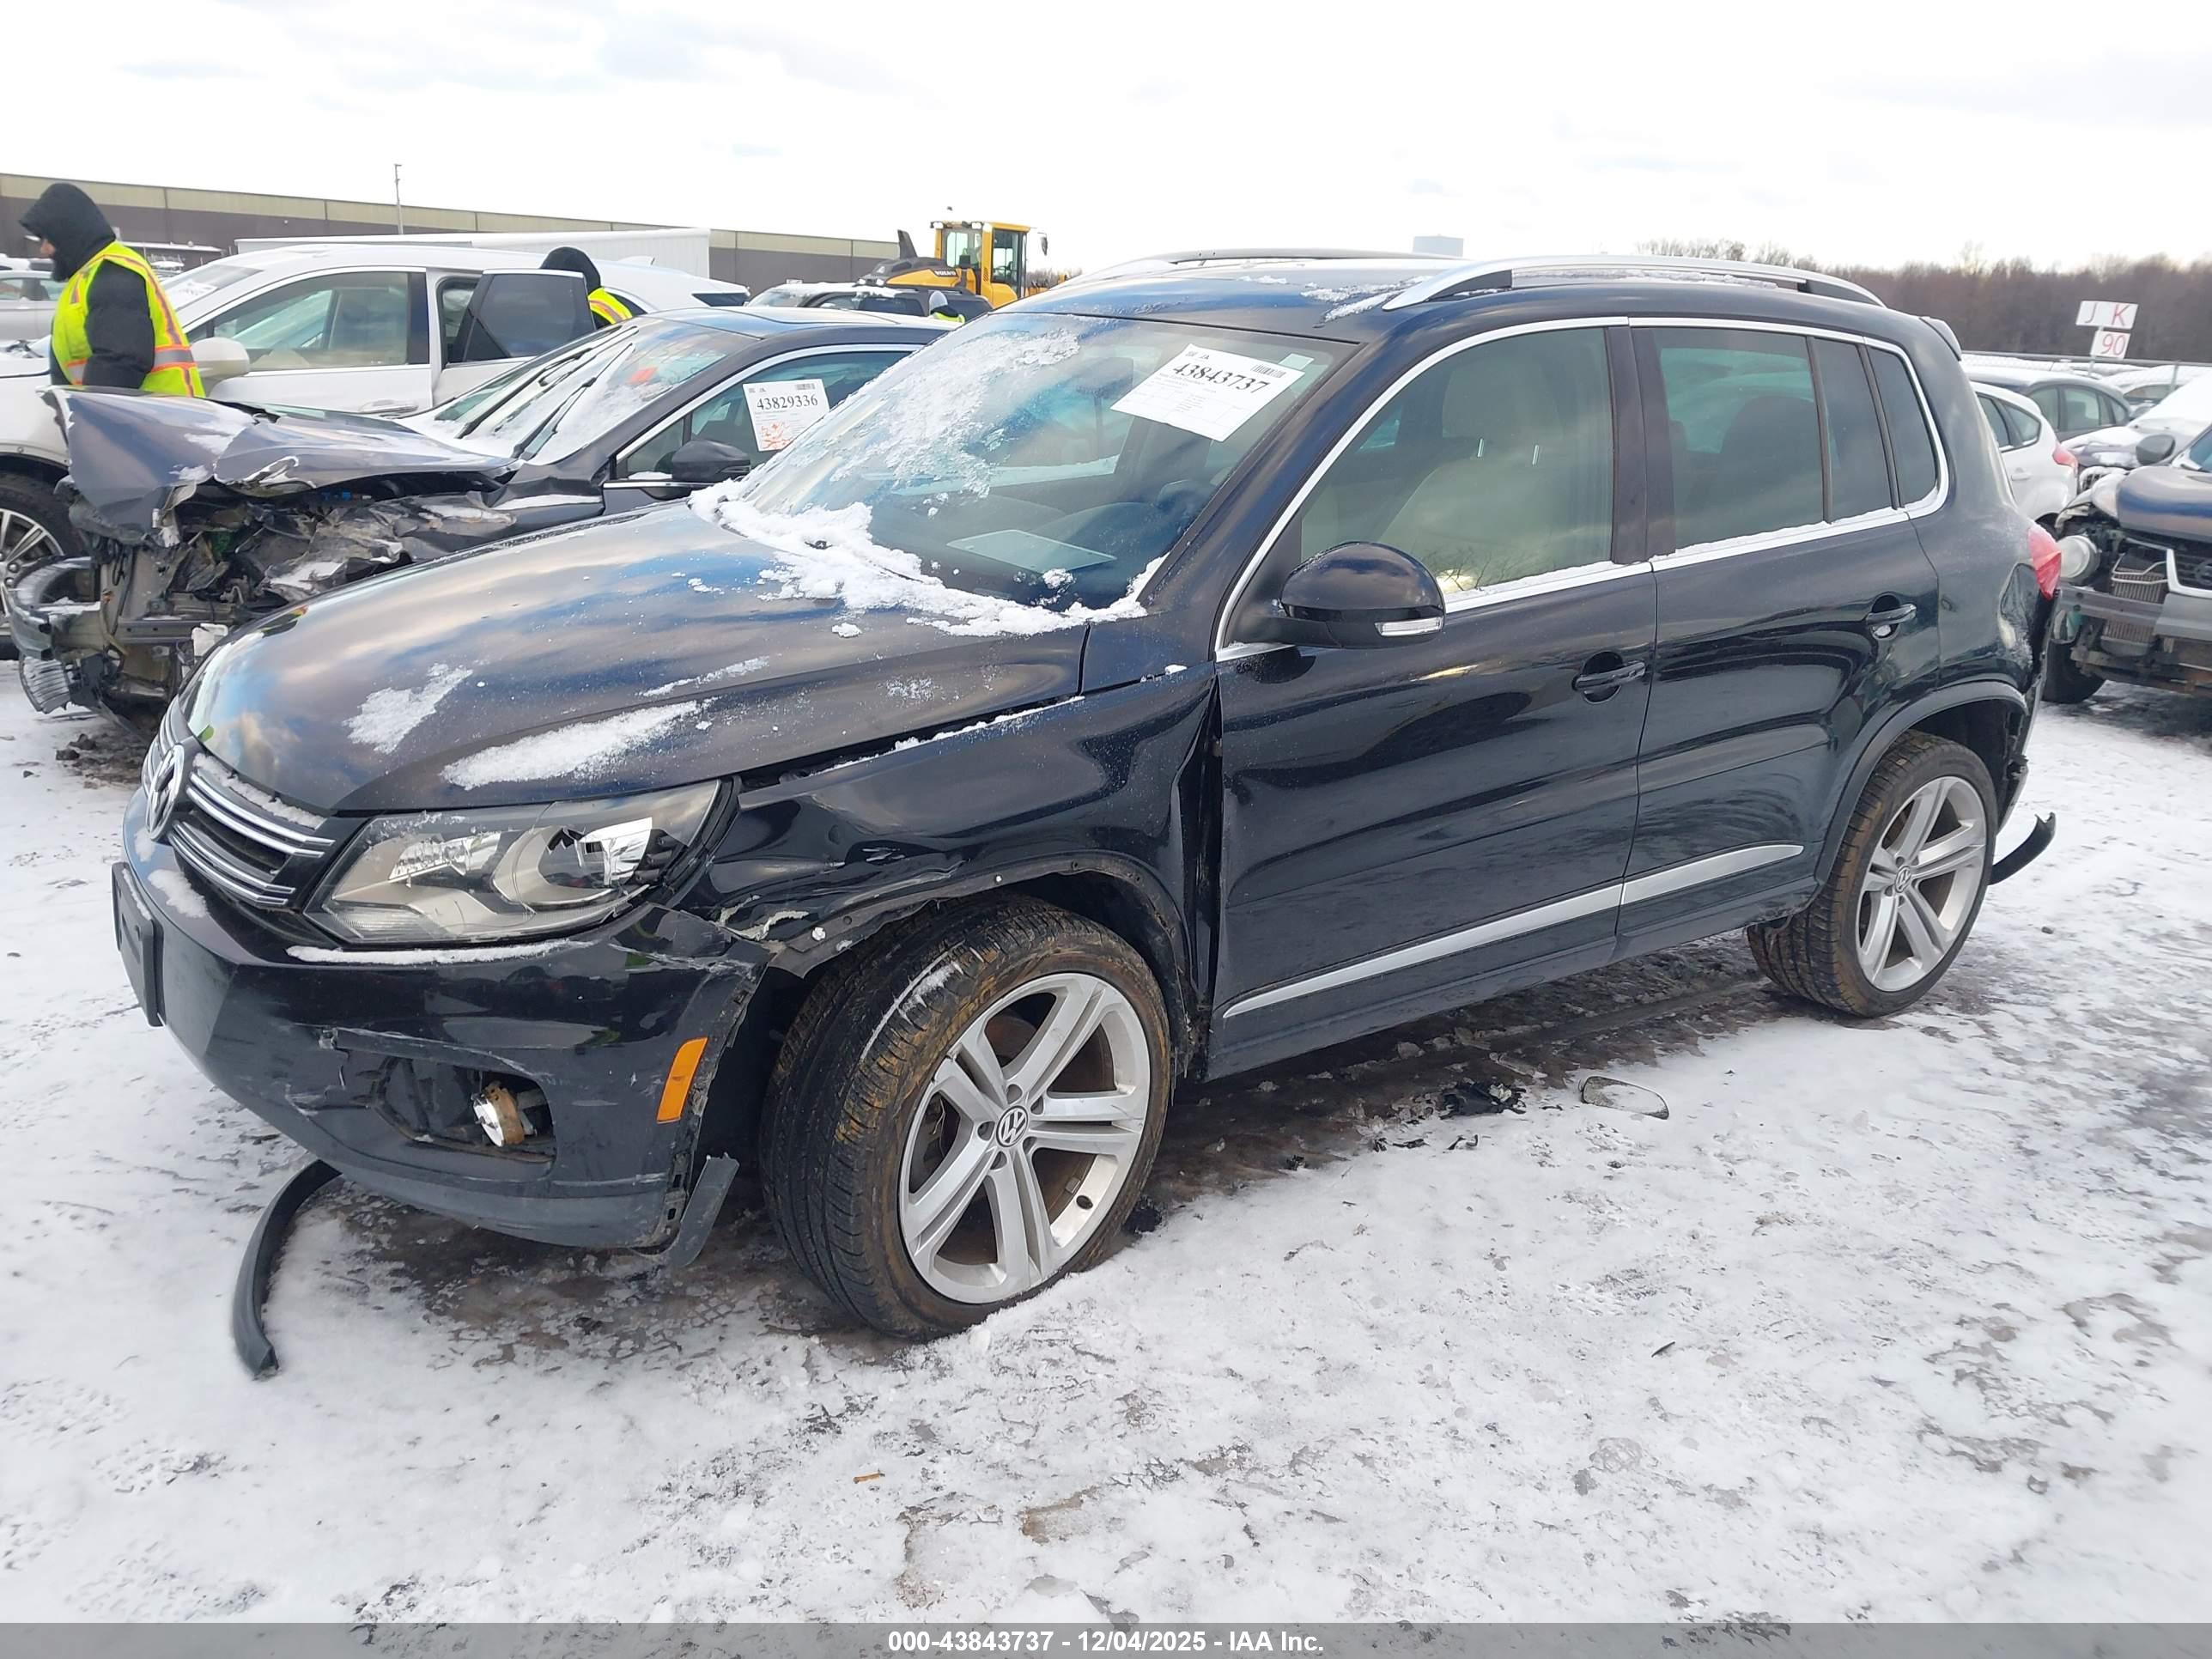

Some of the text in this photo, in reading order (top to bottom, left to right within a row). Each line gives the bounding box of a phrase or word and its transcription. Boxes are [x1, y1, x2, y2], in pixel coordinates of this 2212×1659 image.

[2084, 302, 2130, 326] J K
[2100, 333, 2126, 356] 90
[1173, 362, 1271, 393] 43843737
[757, 394, 818, 410] 43829336
